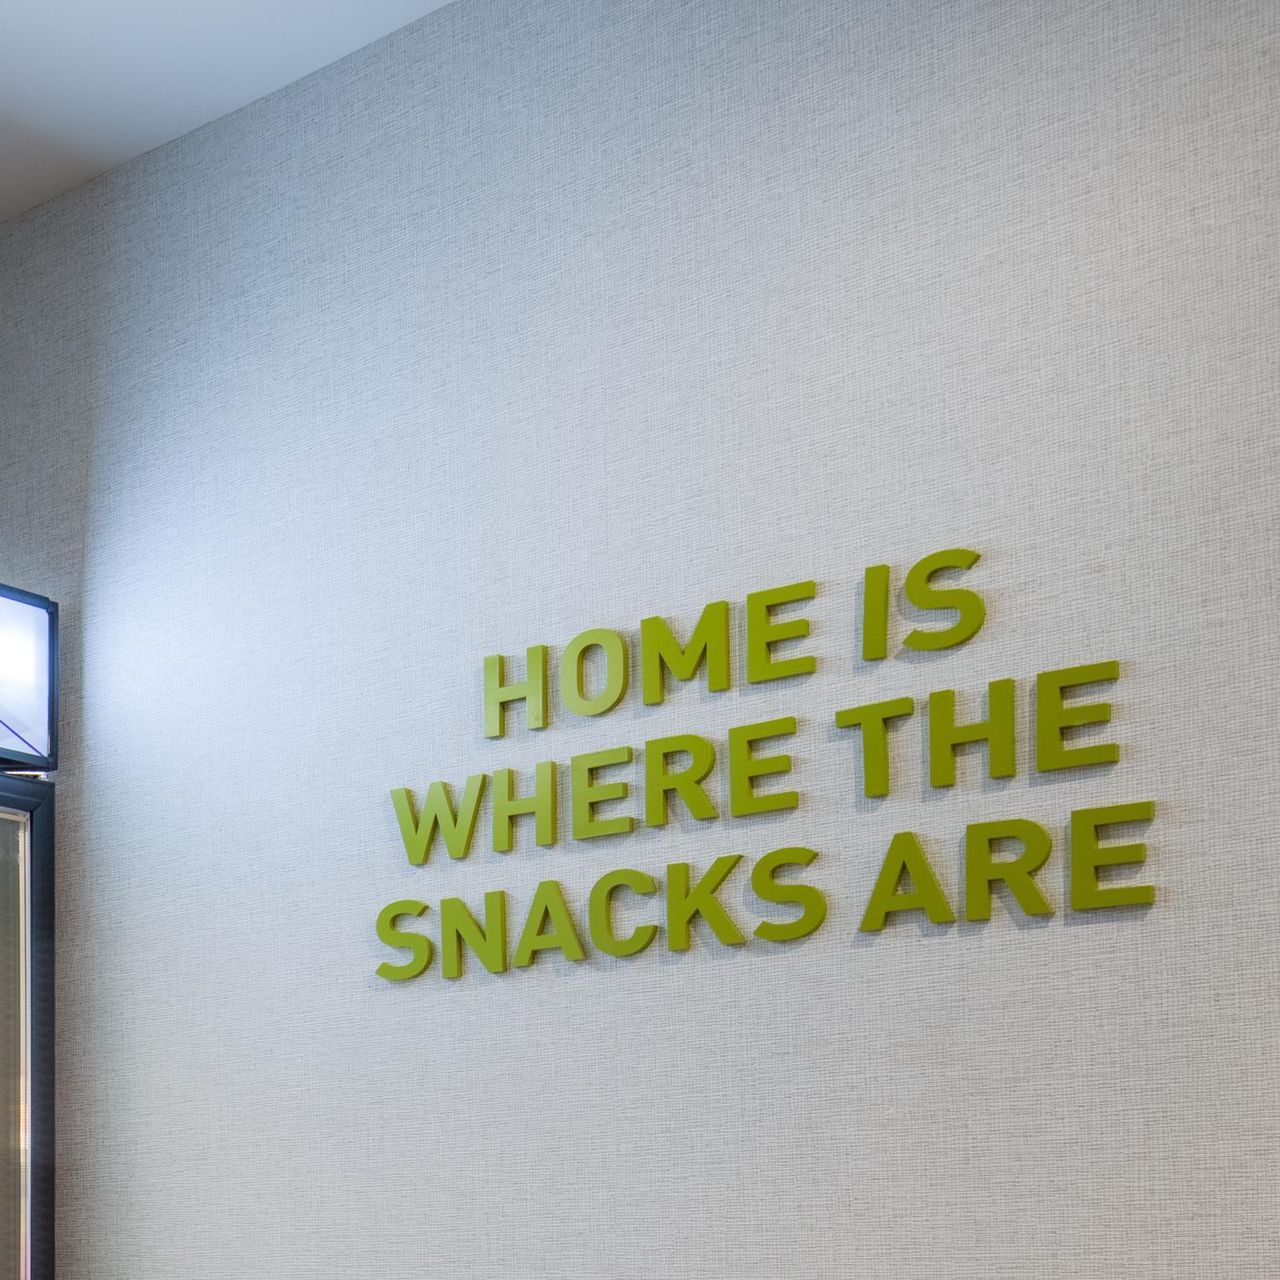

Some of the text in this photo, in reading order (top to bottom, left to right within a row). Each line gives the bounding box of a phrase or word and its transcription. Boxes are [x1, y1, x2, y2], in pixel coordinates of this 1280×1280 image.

[482, 547, 987, 740] HOME IS
[391, 659, 1120, 867] WHERE THE
[375, 801, 1156, 982] SNACKS ARE
